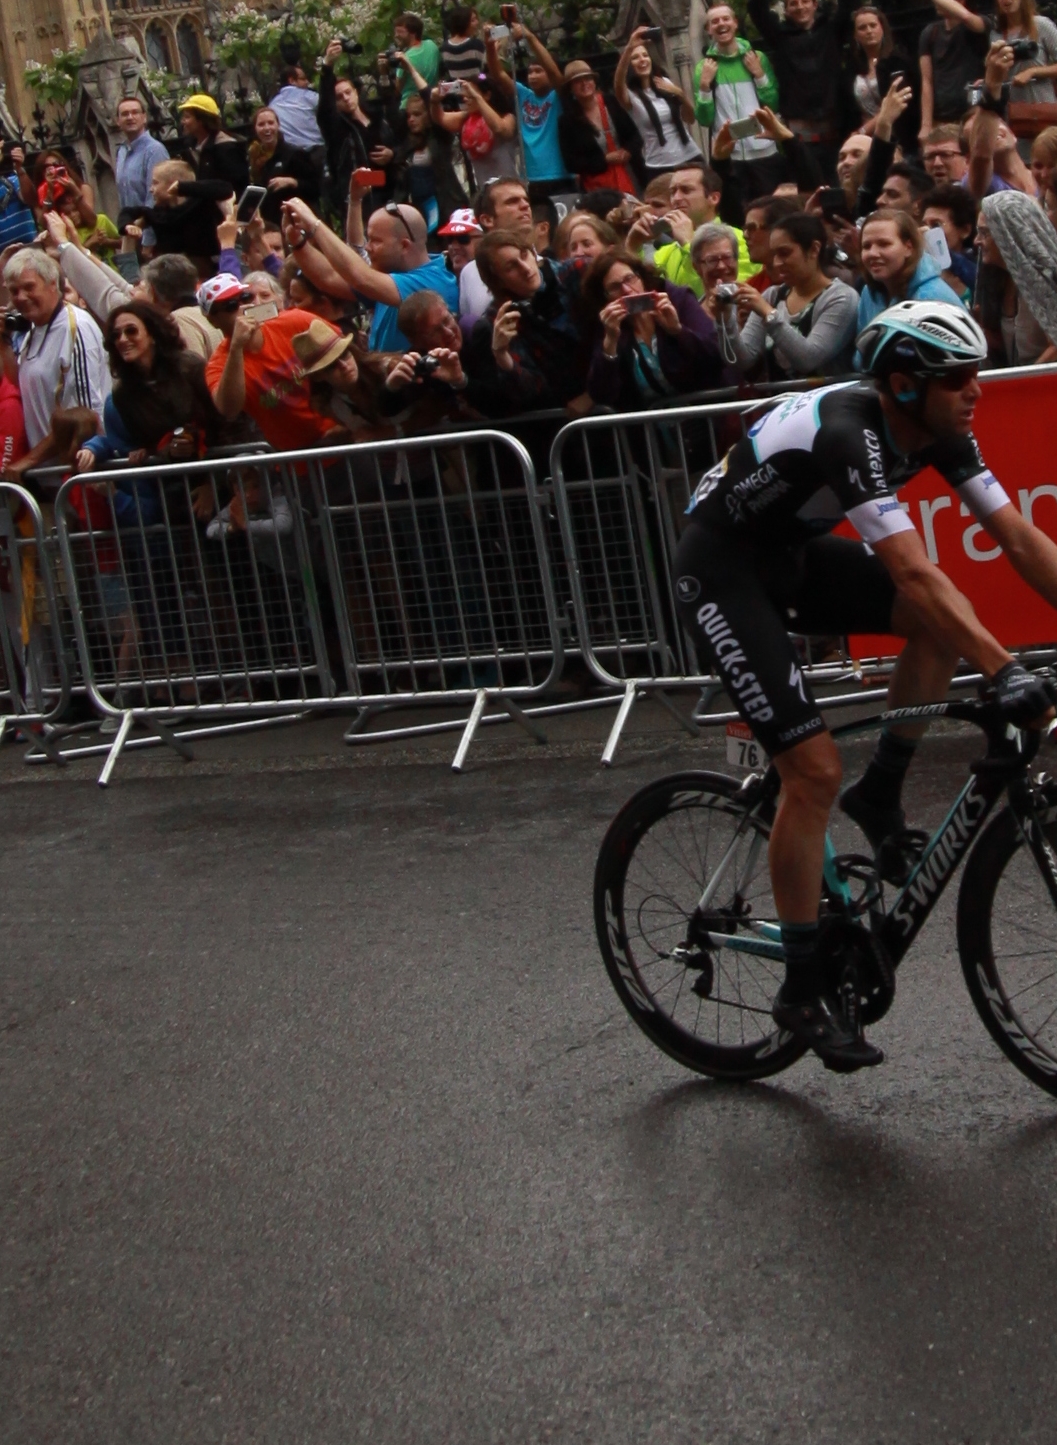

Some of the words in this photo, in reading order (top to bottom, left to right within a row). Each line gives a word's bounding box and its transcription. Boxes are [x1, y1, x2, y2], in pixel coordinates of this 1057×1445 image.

[733, 463, 779, 498] OMEGA
[737, 741, 759, 768] 76
[893, 778, 988, 937] S-WORKS
